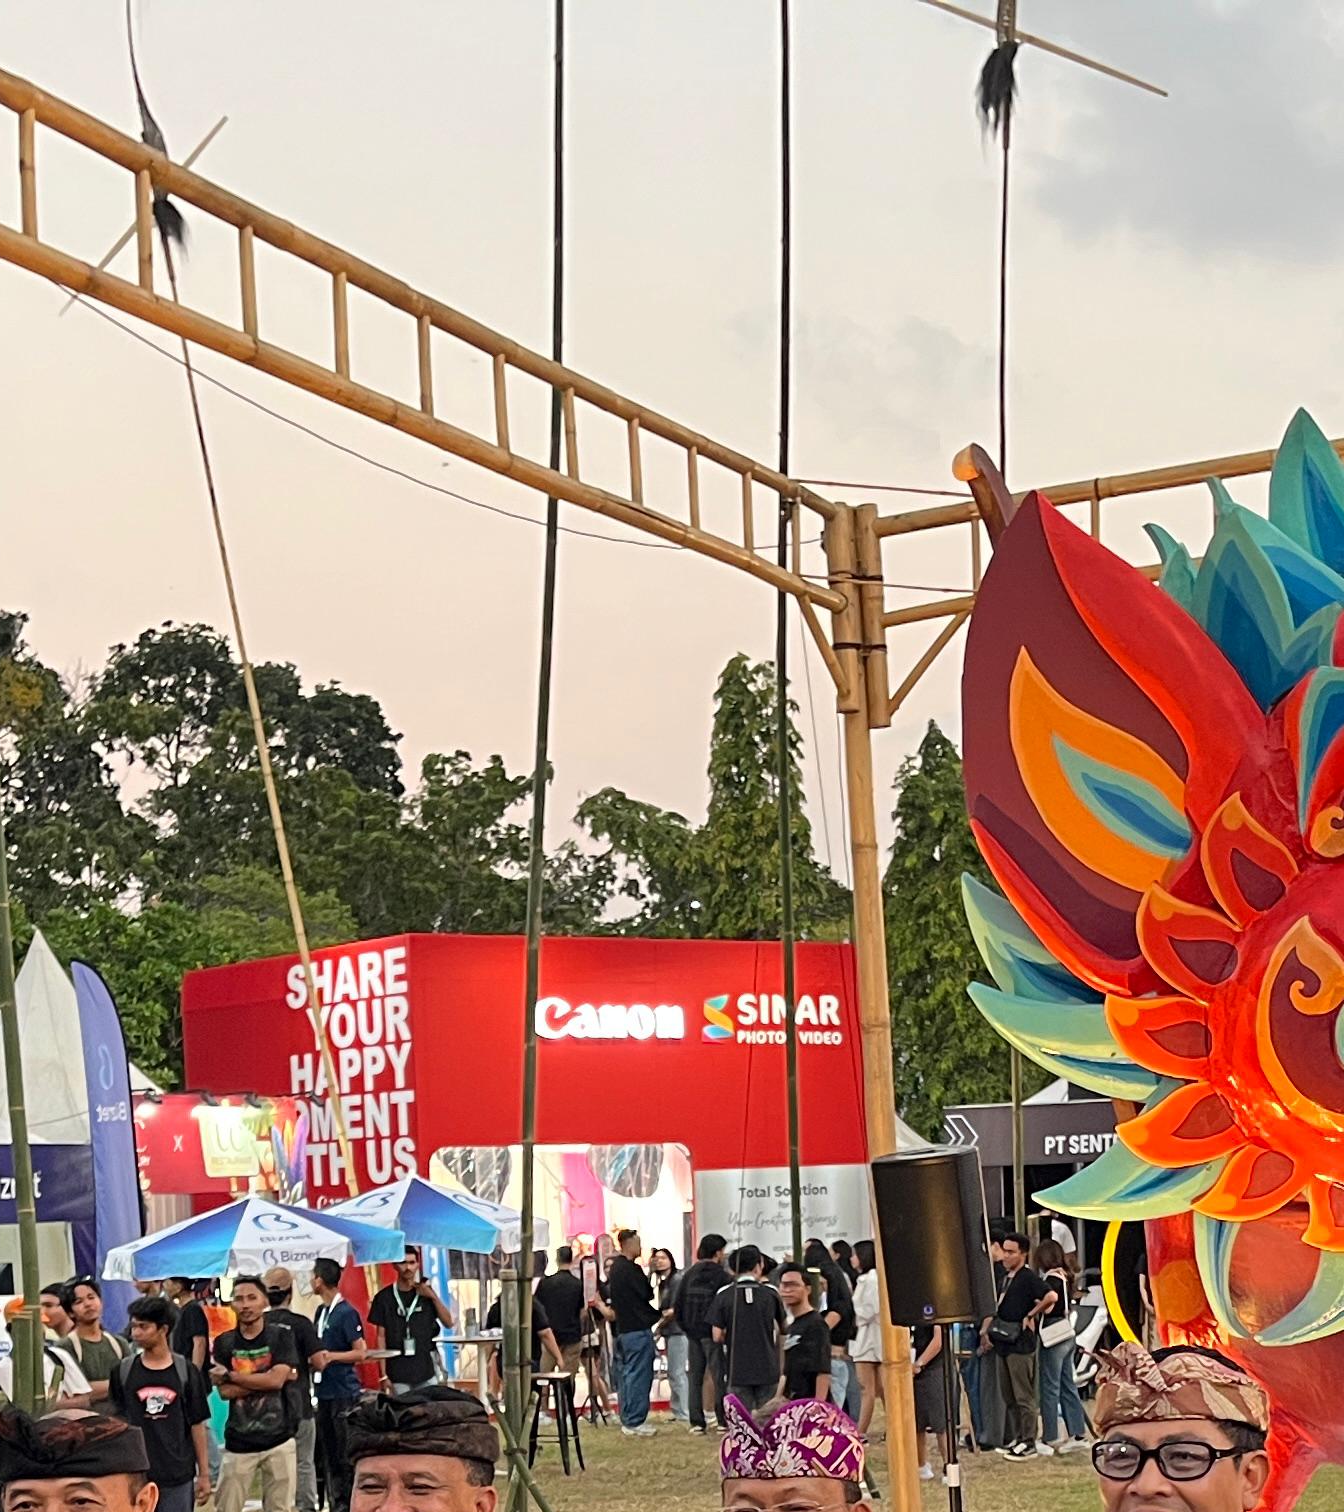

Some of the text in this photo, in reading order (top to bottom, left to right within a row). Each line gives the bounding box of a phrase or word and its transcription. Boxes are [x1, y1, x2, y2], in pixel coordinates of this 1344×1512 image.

[286, 946, 408, 1009] SHARE
[306, 995, 411, 1050] YOUR
[534, 996, 685, 1040] Canon
[737, 1030, 842, 1045] PHOTO VIDEO
[290, 1042, 412, 1095] HAPPY
[296, 1090, 415, 1142] MENT
[307, 1137, 417, 1187] TH US
[1044, 1136, 1065, 1155] PT
[740, 1183, 827, 1199] Total Sotion
